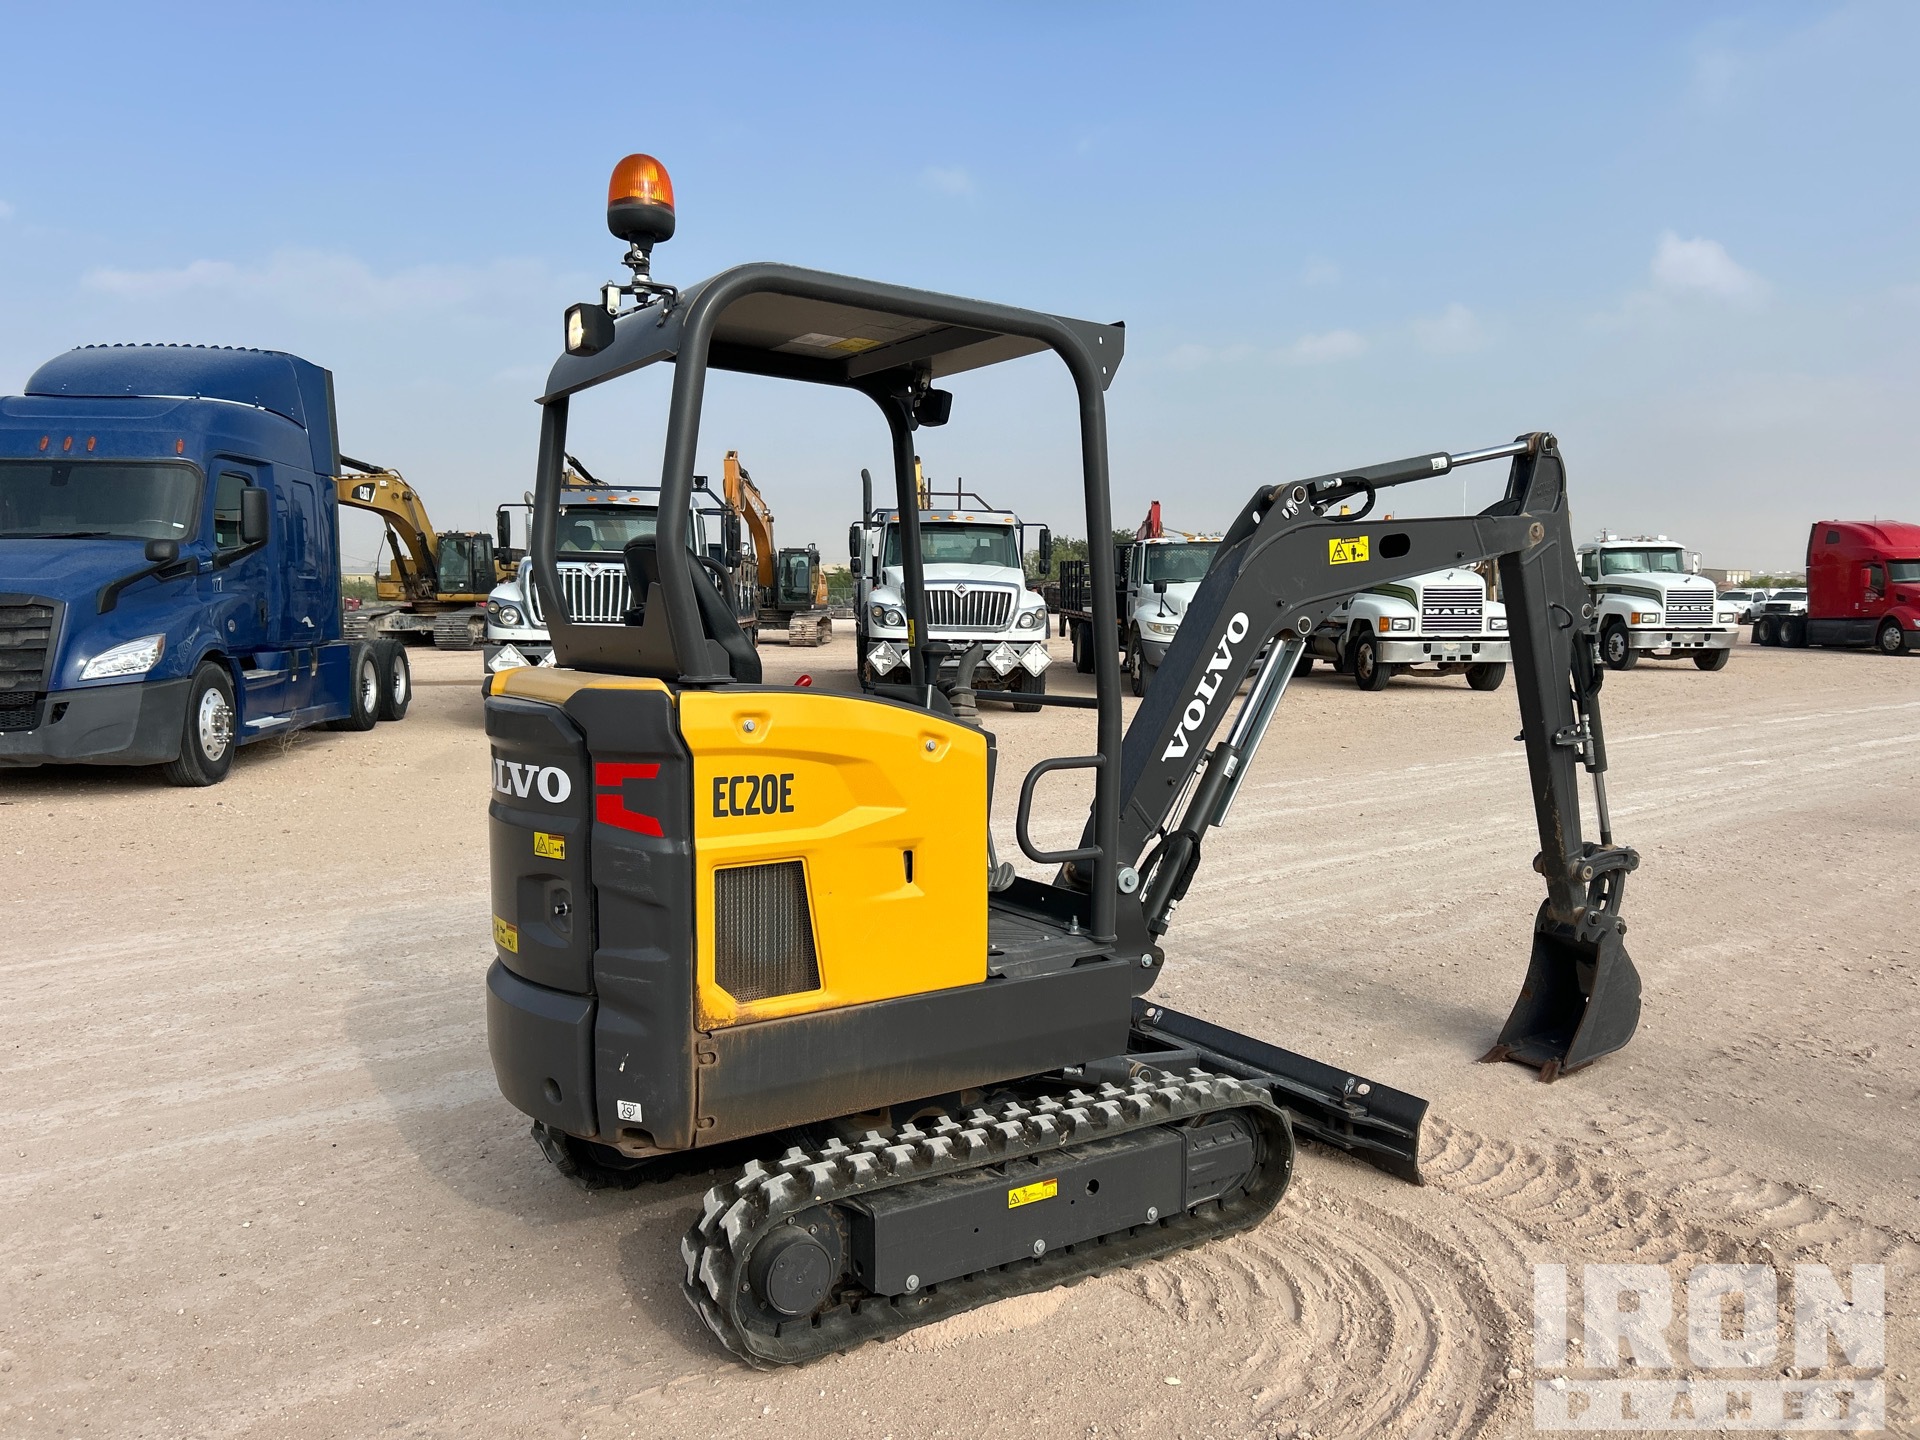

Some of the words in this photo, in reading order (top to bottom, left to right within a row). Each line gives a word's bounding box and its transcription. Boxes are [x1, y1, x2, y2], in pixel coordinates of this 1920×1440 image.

[360, 486, 370, 500] CAT
[1161, 611, 1249, 763] VOLVO
[713, 773, 795, 818] EC20E
